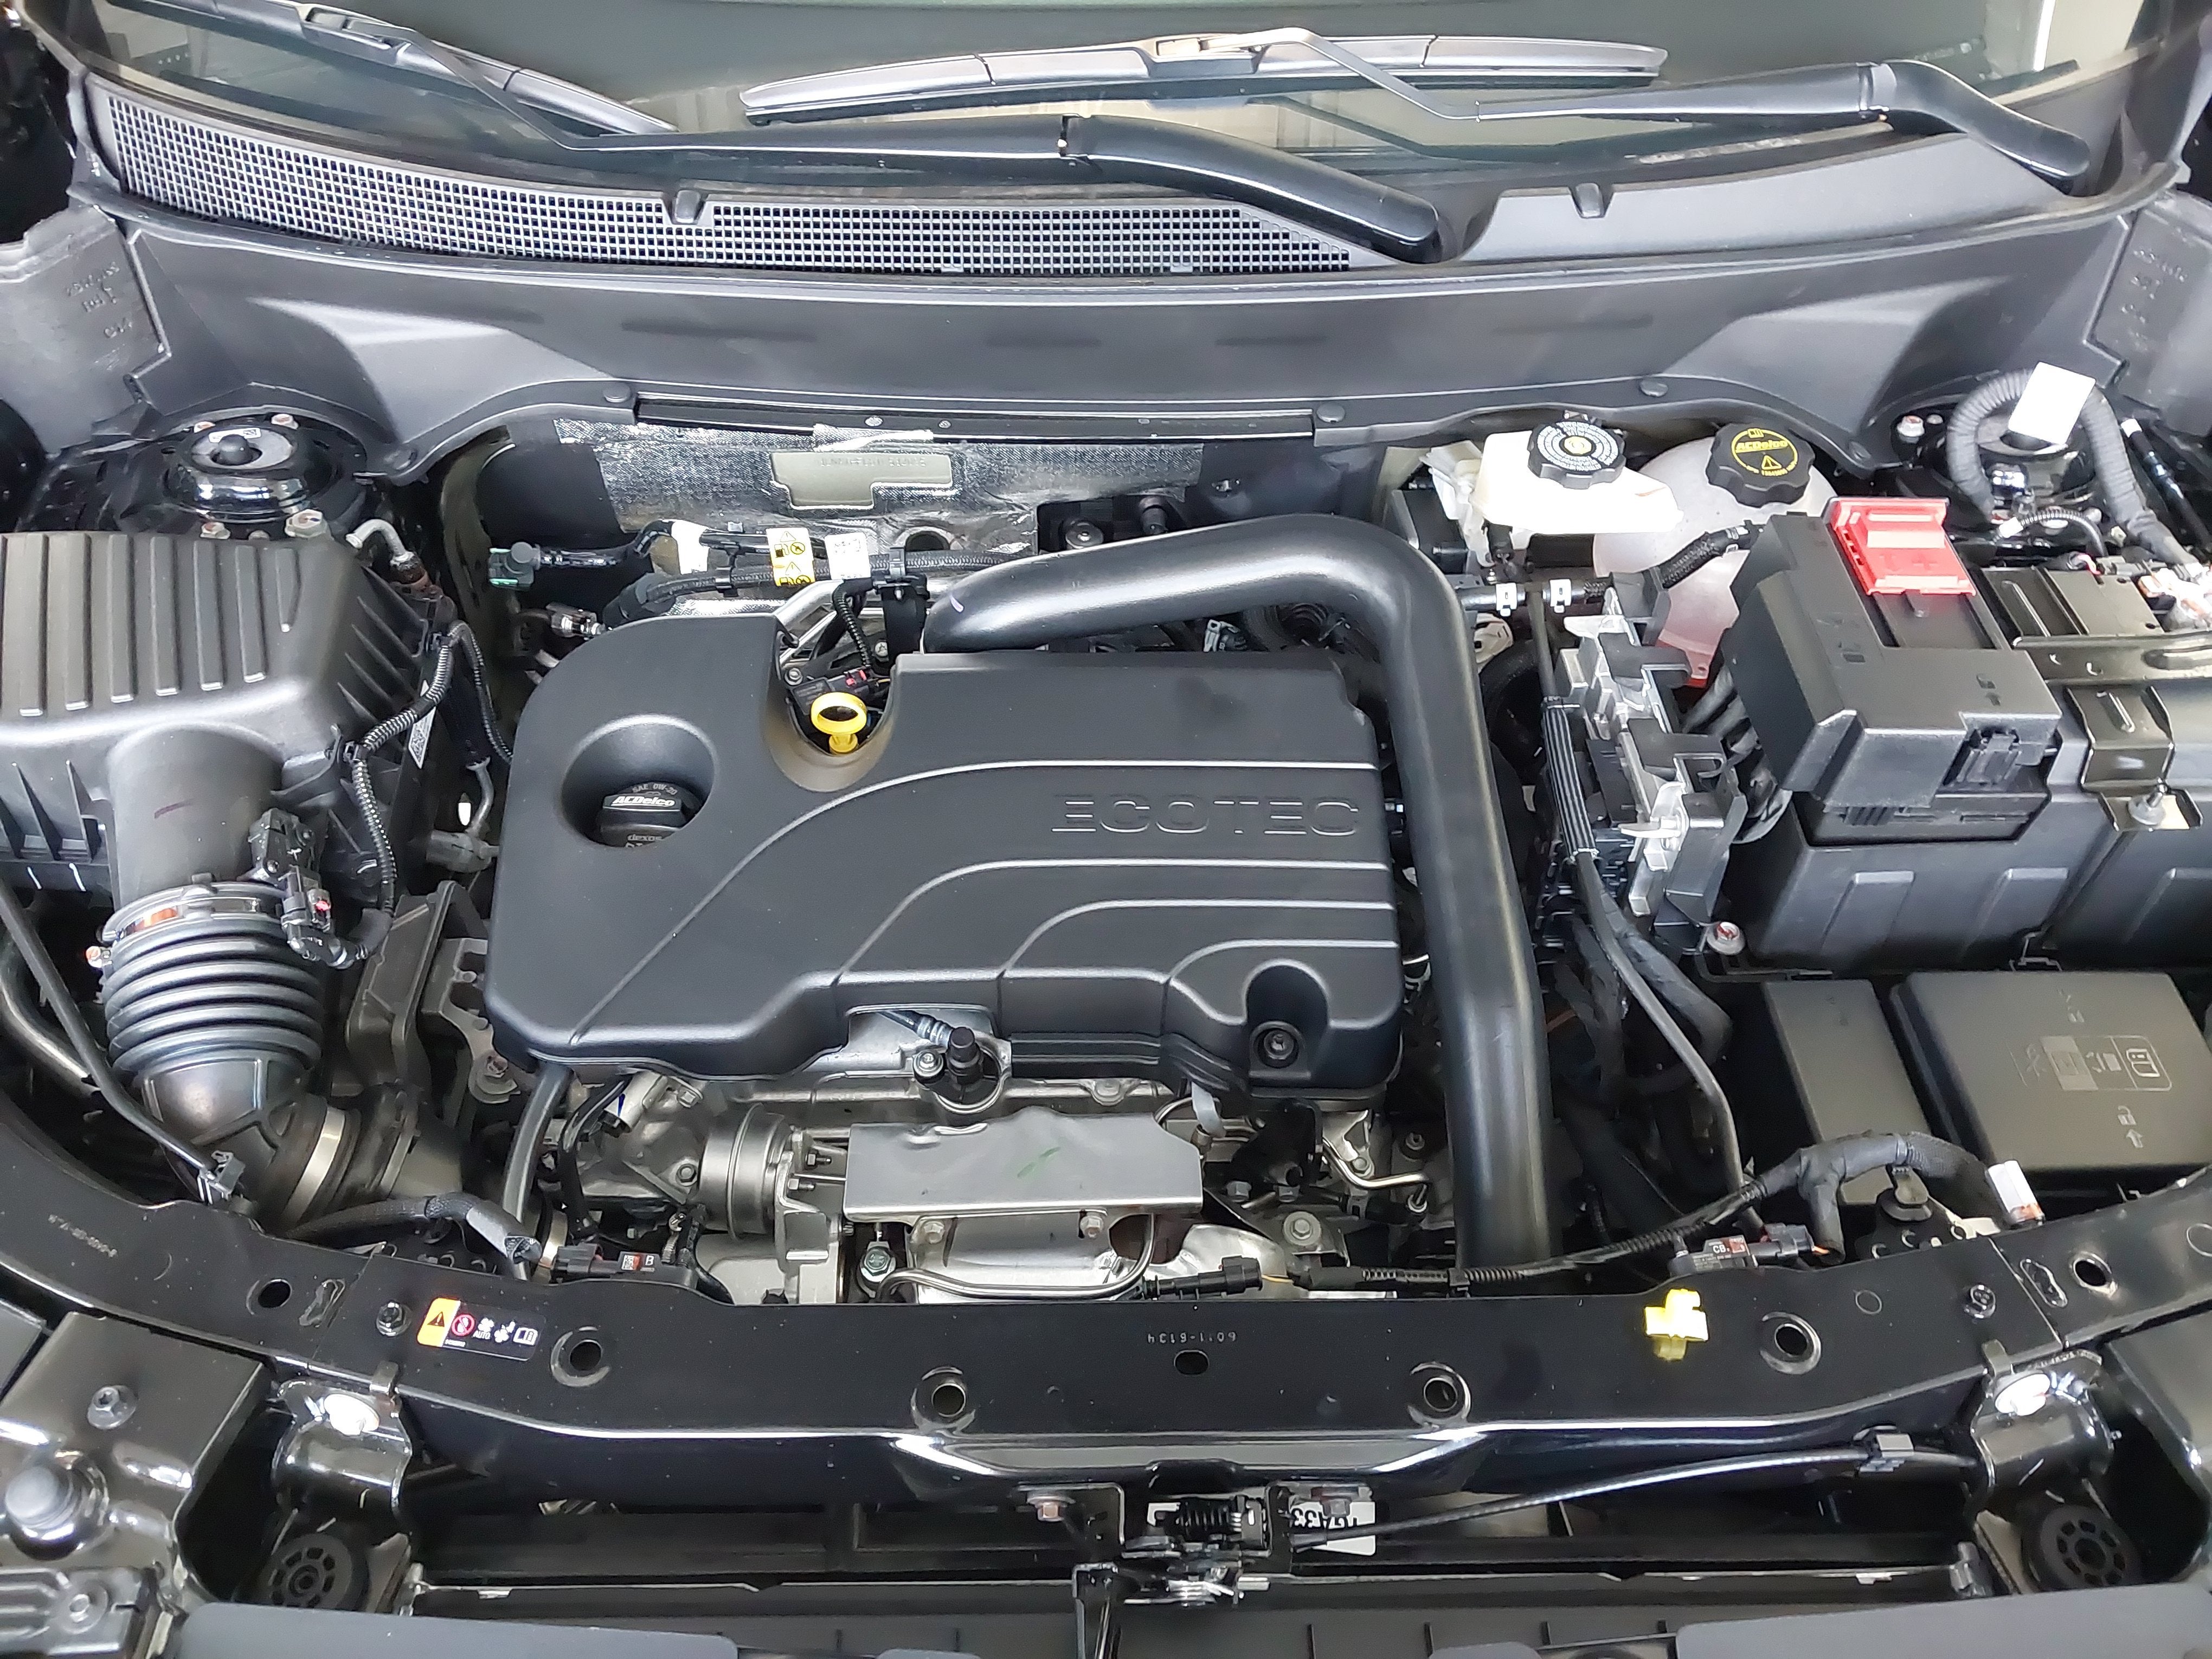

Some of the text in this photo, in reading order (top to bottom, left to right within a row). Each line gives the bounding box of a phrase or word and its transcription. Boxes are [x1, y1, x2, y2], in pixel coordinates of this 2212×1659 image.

[632, 783, 678, 795] SAE 0W-20
[612, 796, 675, 806] ACDelco
[1052, 796, 1359, 835] ECOTEC
[473, 1330, 491, 1340] AUTO
